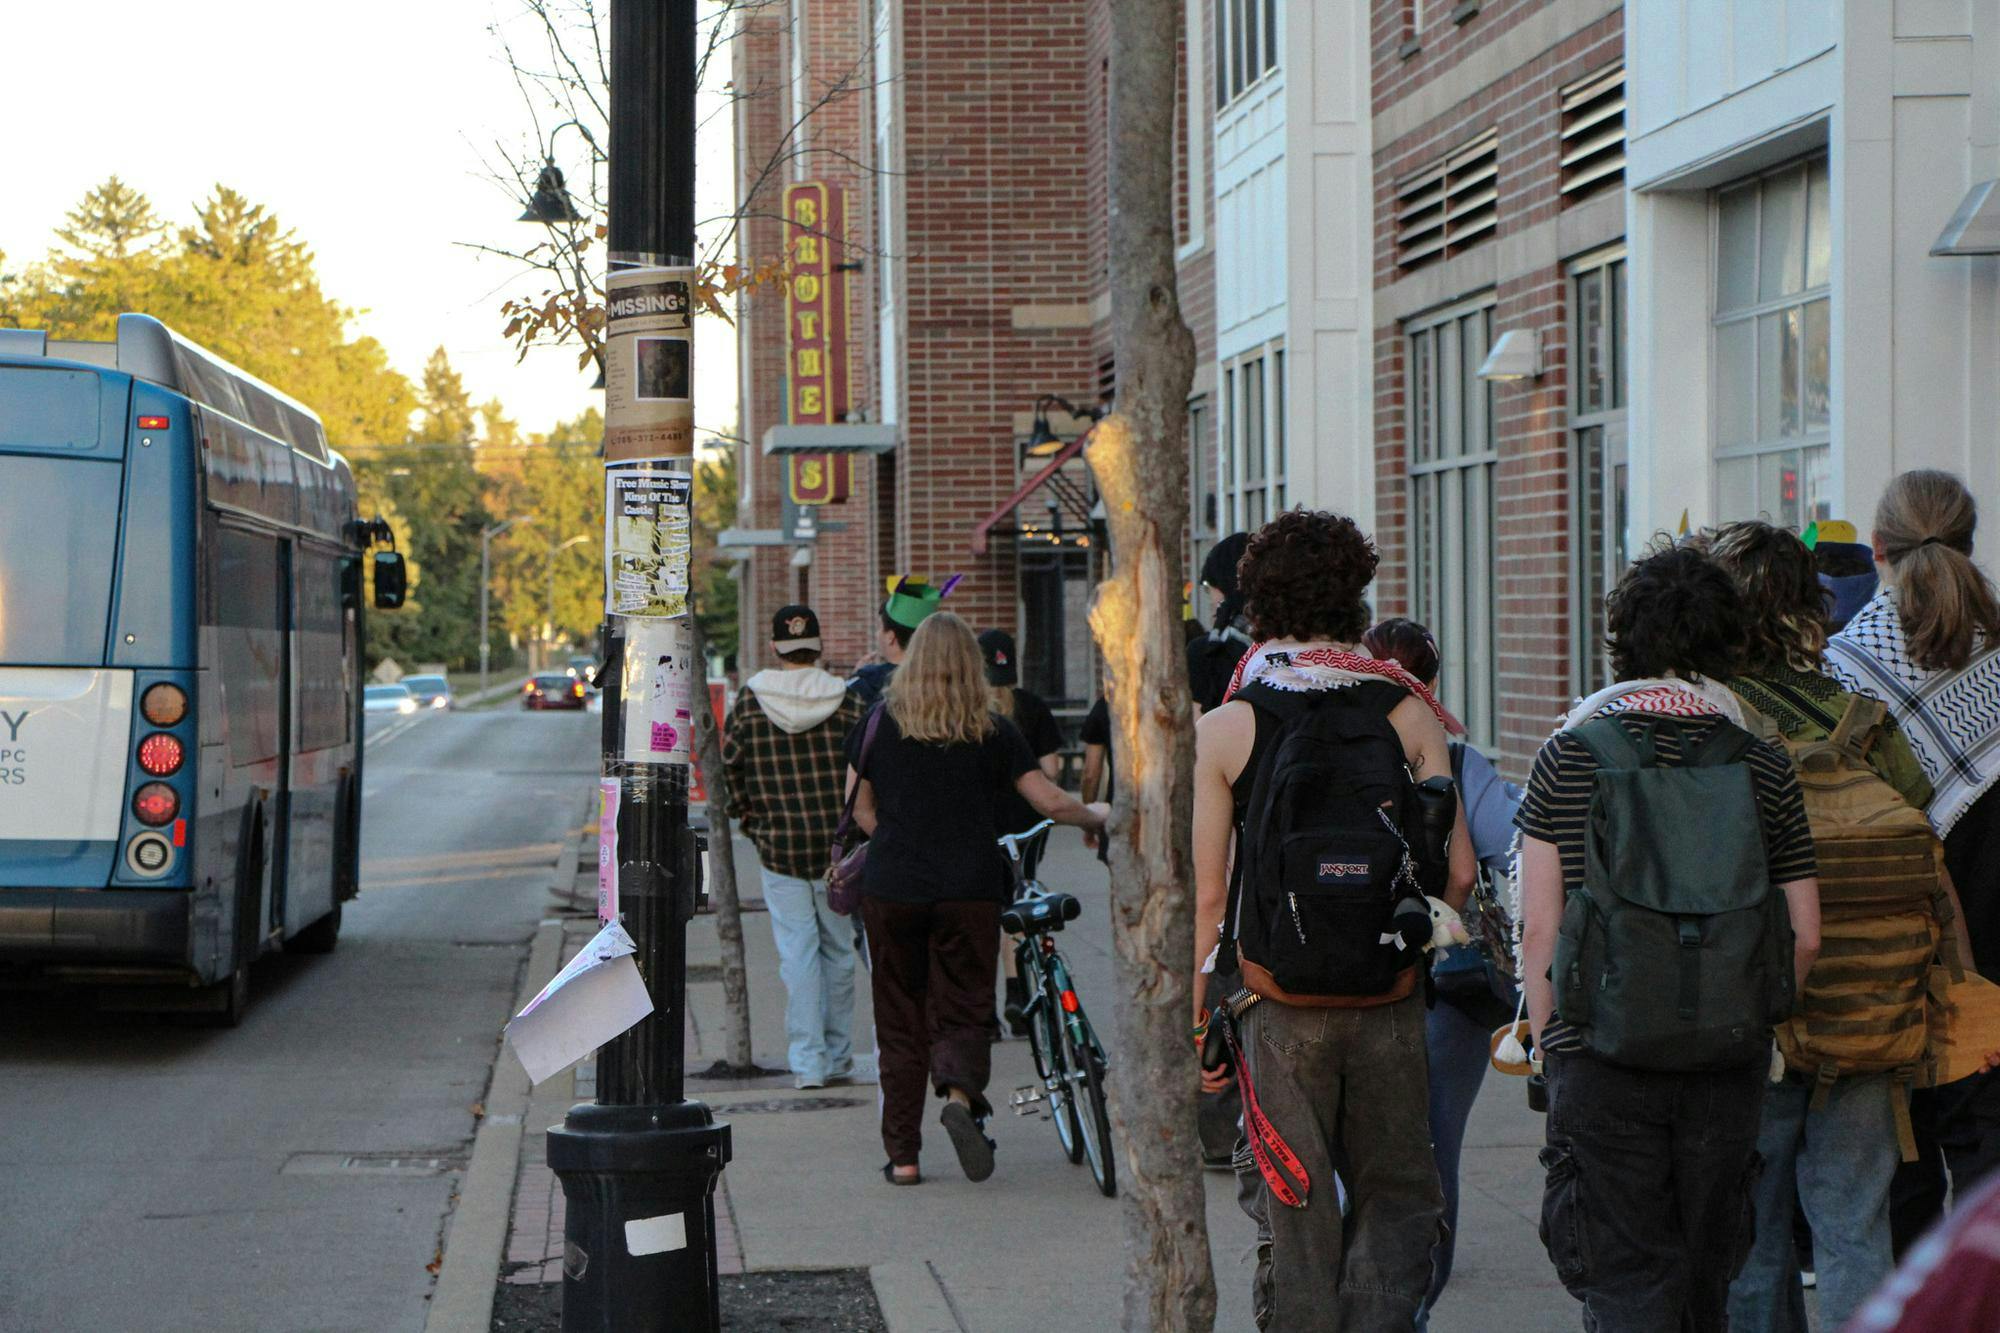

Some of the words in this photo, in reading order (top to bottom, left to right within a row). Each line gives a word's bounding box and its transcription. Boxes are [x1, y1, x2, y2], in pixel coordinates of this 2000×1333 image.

[611, 294, 678, 318] MISSING
[794, 198, 823, 490] BROTHES
[616, 478, 637, 489] Free
[638, 478, 669, 489] Music
[624, 491, 647, 504] King
[649, 491, 661, 502] Of
[662, 492, 680, 503] The
[624, 504, 653, 515] Castle
[1319, 863, 1369, 877] JANSPORT
